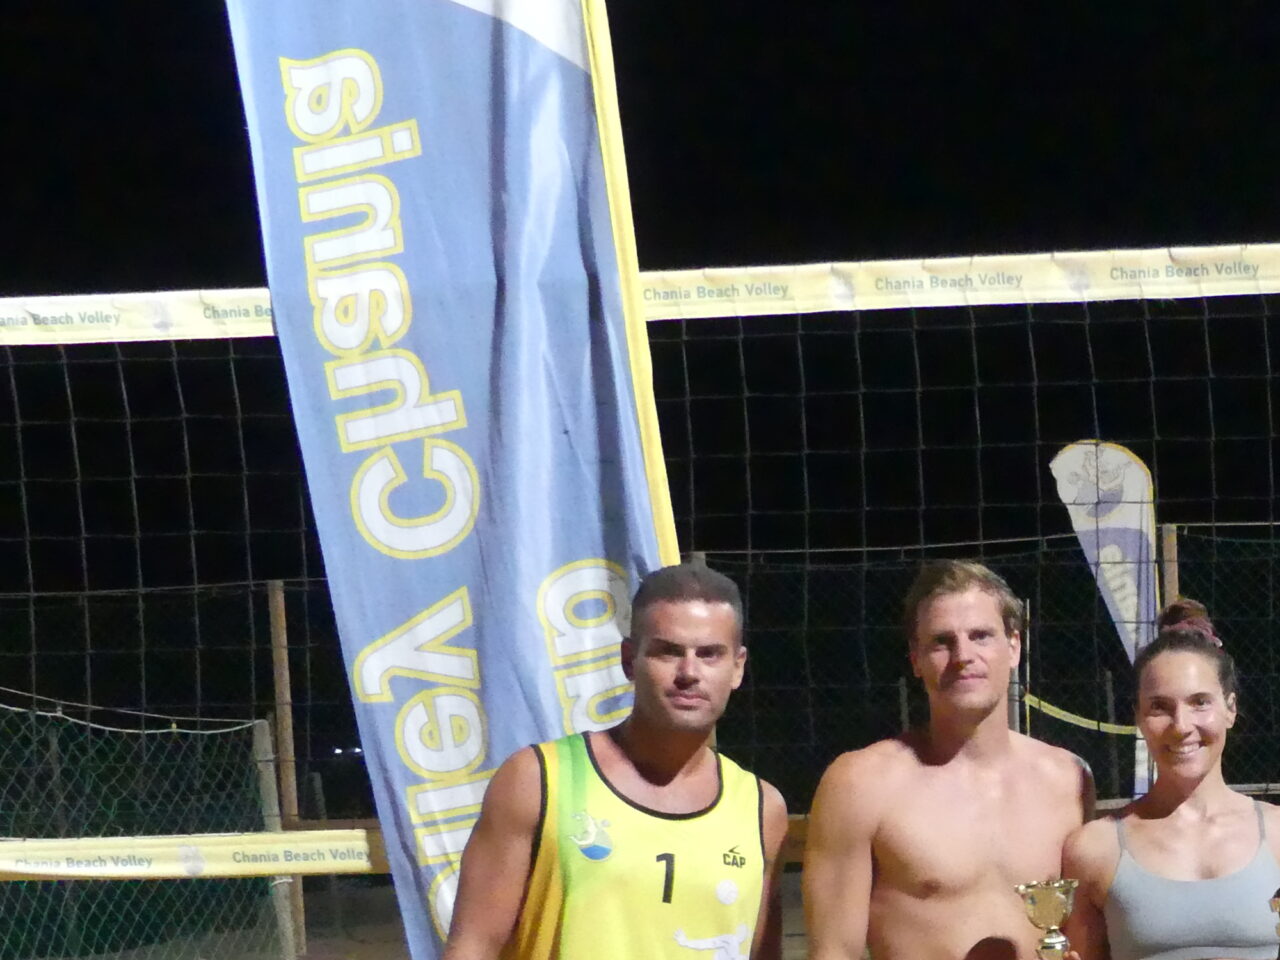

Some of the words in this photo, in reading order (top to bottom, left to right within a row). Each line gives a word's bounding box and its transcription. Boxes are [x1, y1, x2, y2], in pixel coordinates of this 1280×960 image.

[1110, 267, 1160, 280] Chania
[1165, 264, 1209, 278] Beach
[1214, 262, 1260, 277] Volley
[874, 278, 924, 291] Chania
[930, 274, 973, 288] Beach
[978, 272, 1023, 288] Volley
[643, 288, 690, 301] Chania
[697, 285, 739, 299] Beach
[745, 283, 789, 298] Volley
[0, 316, 28, 326] ania
[33, 313, 74, 326] Beach
[78, 311, 121, 327] Volley
[203, 305, 250, 321] Chania
[232, 851, 279, 864] Chania
[283, 849, 325, 862] Beach
[328, 848, 371, 863] Volley
[723, 853, 746, 868] CAP
[656, 853, 675, 904] 1
